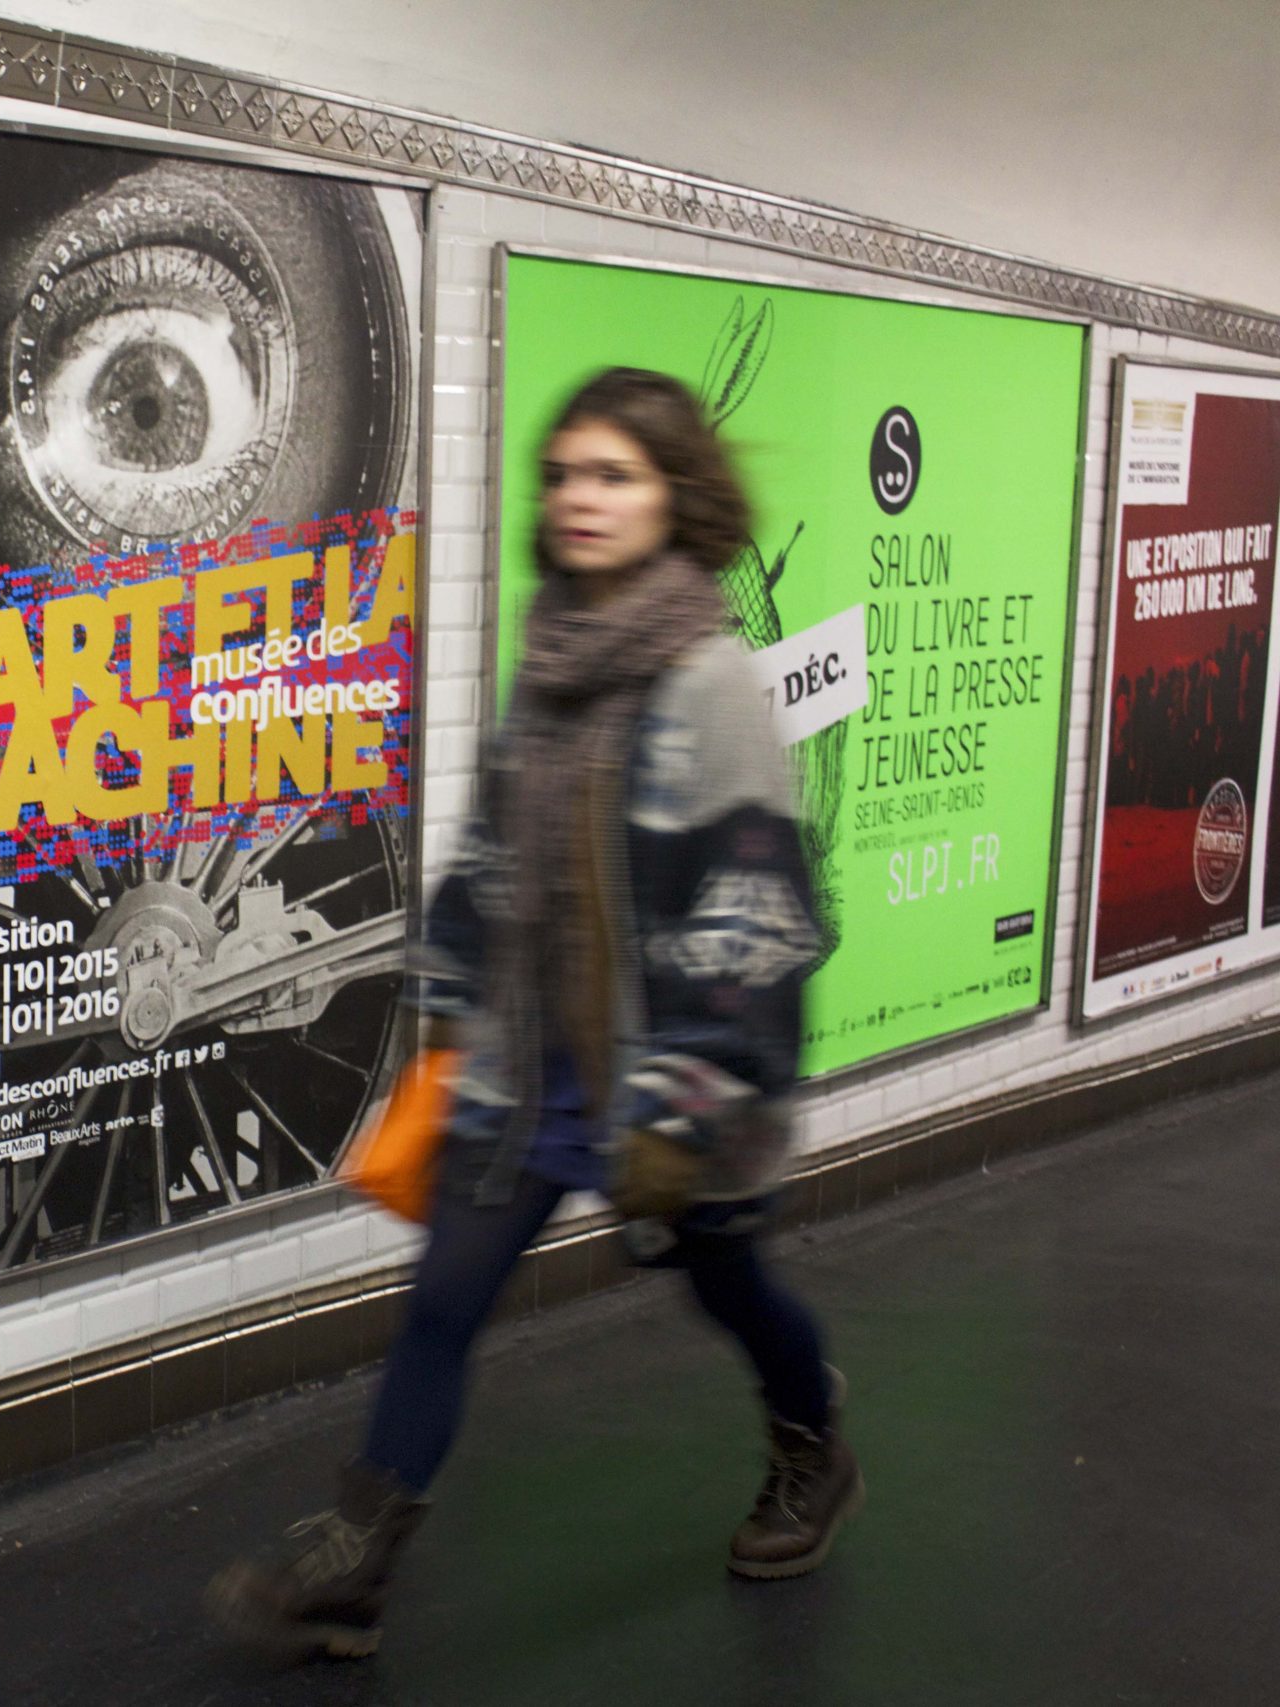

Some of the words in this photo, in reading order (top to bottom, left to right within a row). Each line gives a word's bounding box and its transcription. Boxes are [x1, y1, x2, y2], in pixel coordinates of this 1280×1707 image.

[869, 533, 951, 589] SALON
[1127, 537, 1152, 579] UNE
[1154, 529, 1221, 575] EXPOSITION
[1224, 527, 1244, 565] QUI
[1245, 523, 1272, 562] FAIT
[195, 552, 315, 660] ET
[324, 533, 416, 648] LA
[1186, 574, 1205, 613] KM
[1208, 572, 1222, 610] DE
[1225, 568, 1257, 608] LONG.
[866, 601, 898, 656] DU
[912, 597, 990, 652] LIVRE
[1003, 595, 1033, 645] ET
[190, 627, 302, 690] musée
[306, 618, 362, 661] des
[783, 652, 847, 707] DÉC.
[190, 677, 401, 732] confluences
[863, 669, 894, 724] DE
[909, 664, 939, 718] LA
[952, 655, 1044, 713] PRESSE
[857, 722, 987, 791] JEUNESSE
[854, 782, 986, 831] SEINE-SAINT-DENIS
[887, 832, 1000, 905] SLPJ.FR
[29, 1100, 75, 1120] RHÔNE
[11, 1137, 43, 1153] Matin
